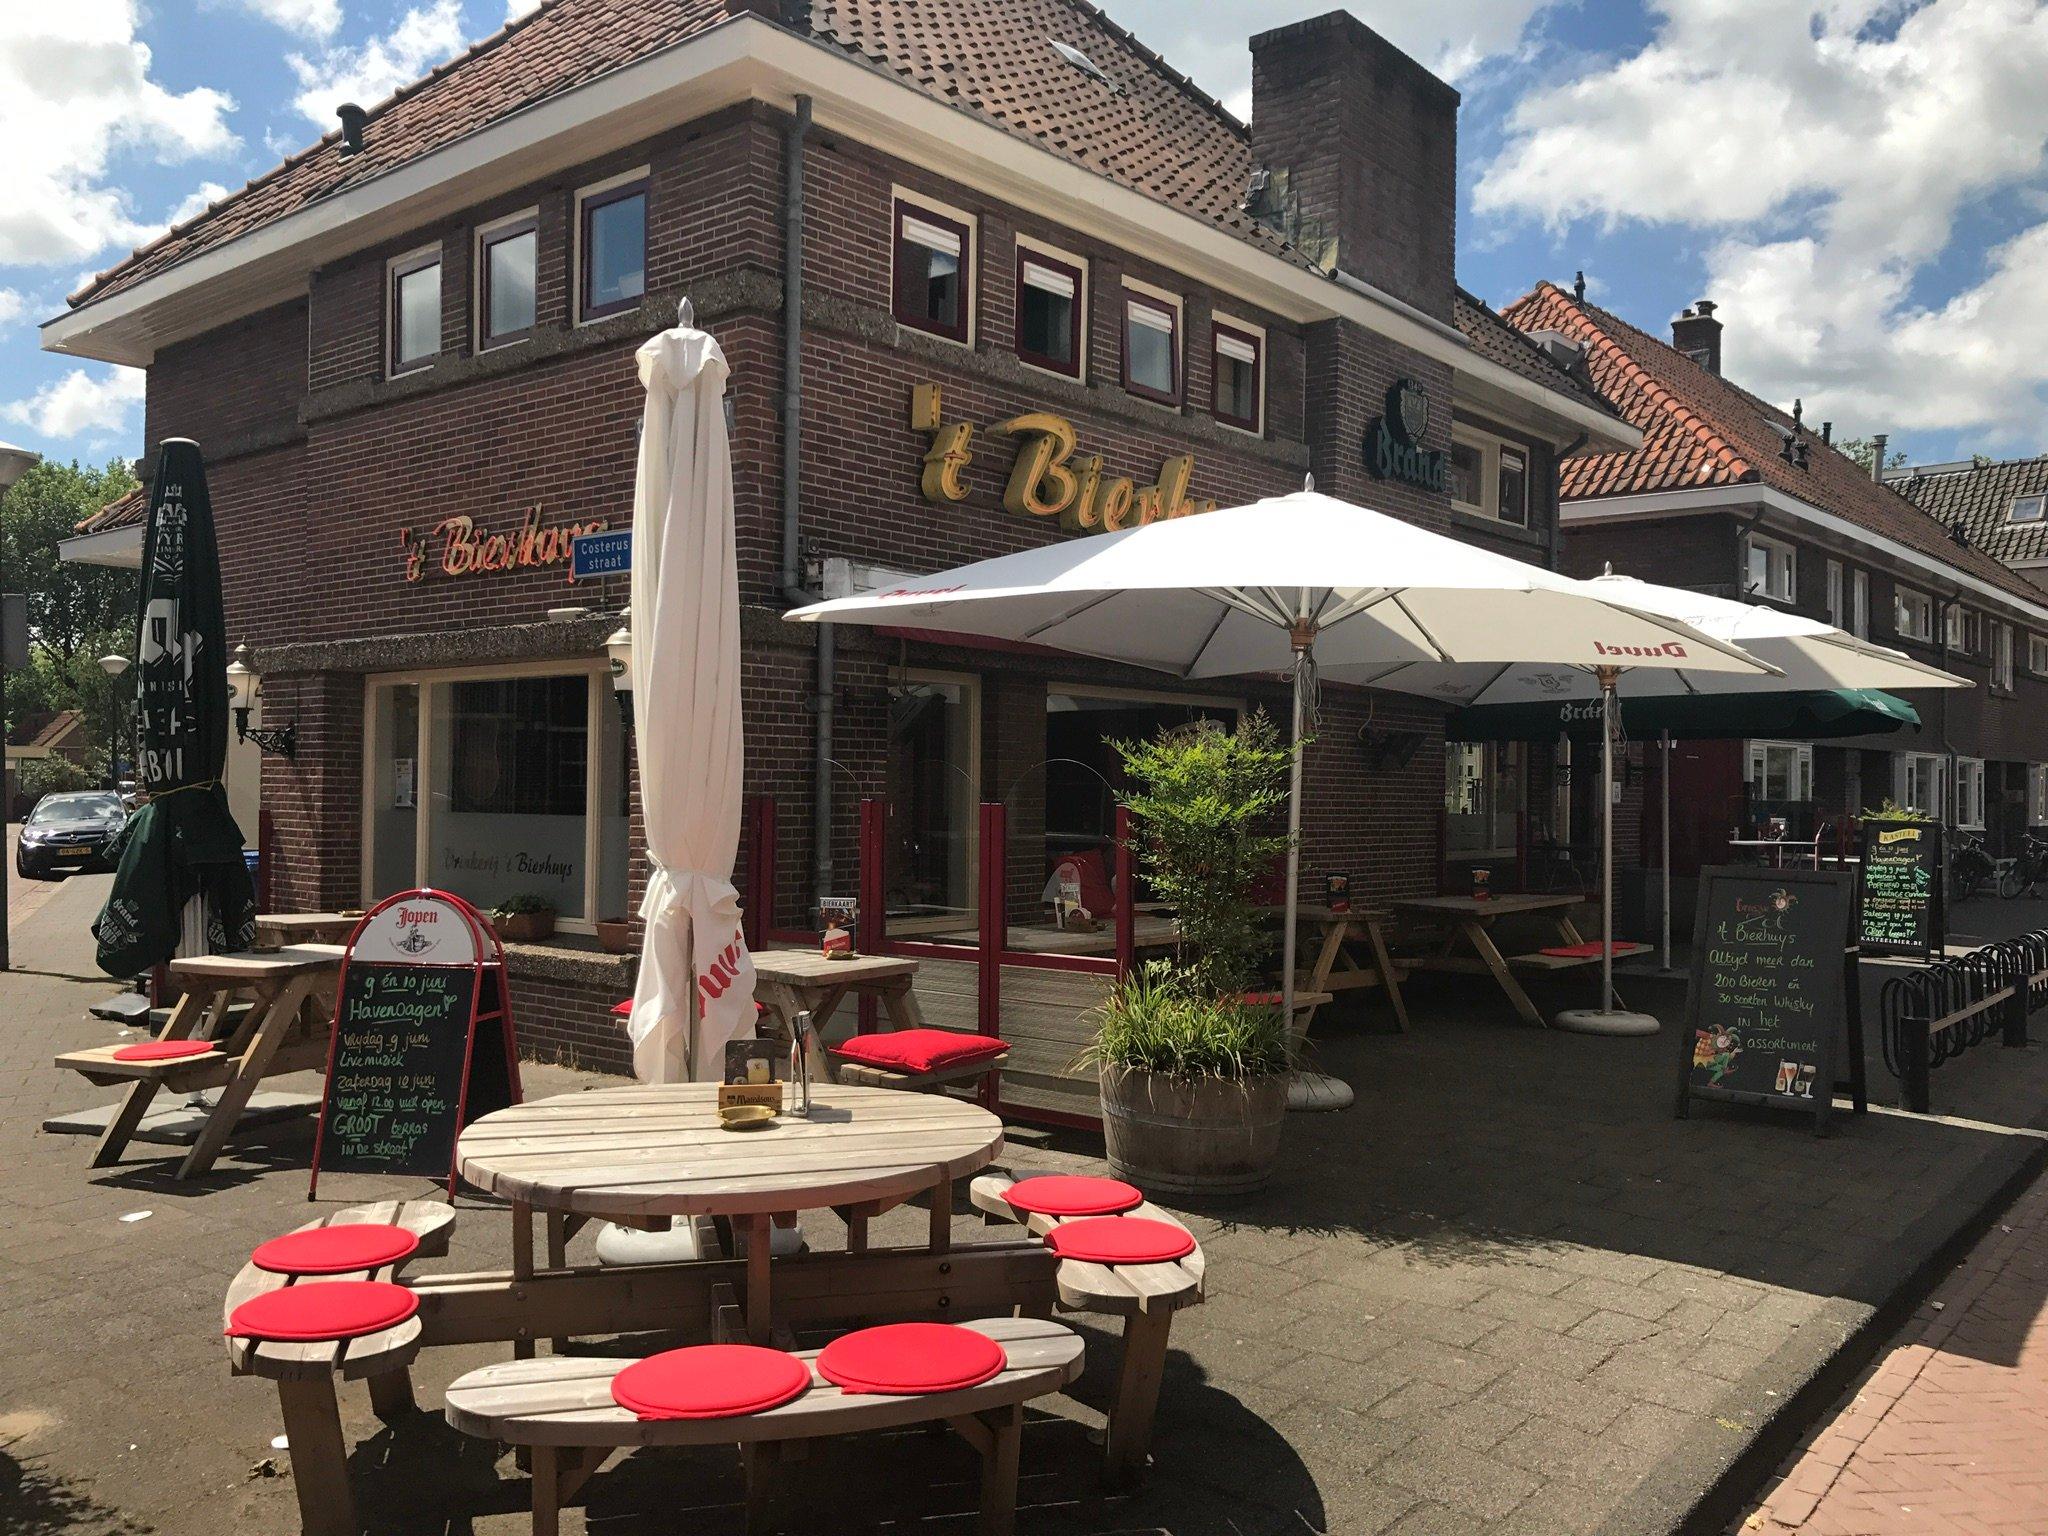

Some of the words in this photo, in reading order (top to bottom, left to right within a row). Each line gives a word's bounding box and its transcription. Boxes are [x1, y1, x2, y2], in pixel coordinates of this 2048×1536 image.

[912, 383, 973, 500] 't
[1374, 414, 1446, 493] Brand
[581, 537, 629, 555] Costerus
[589, 555, 622, 570] straat
[515, 852, 573, 882] Bierhuys
[396, 907, 438, 928] Jopen
[1790, 954, 1815, 968] dan
[1714, 973, 1736, 988] 200
[1760, 1010, 1780, 1028] het
